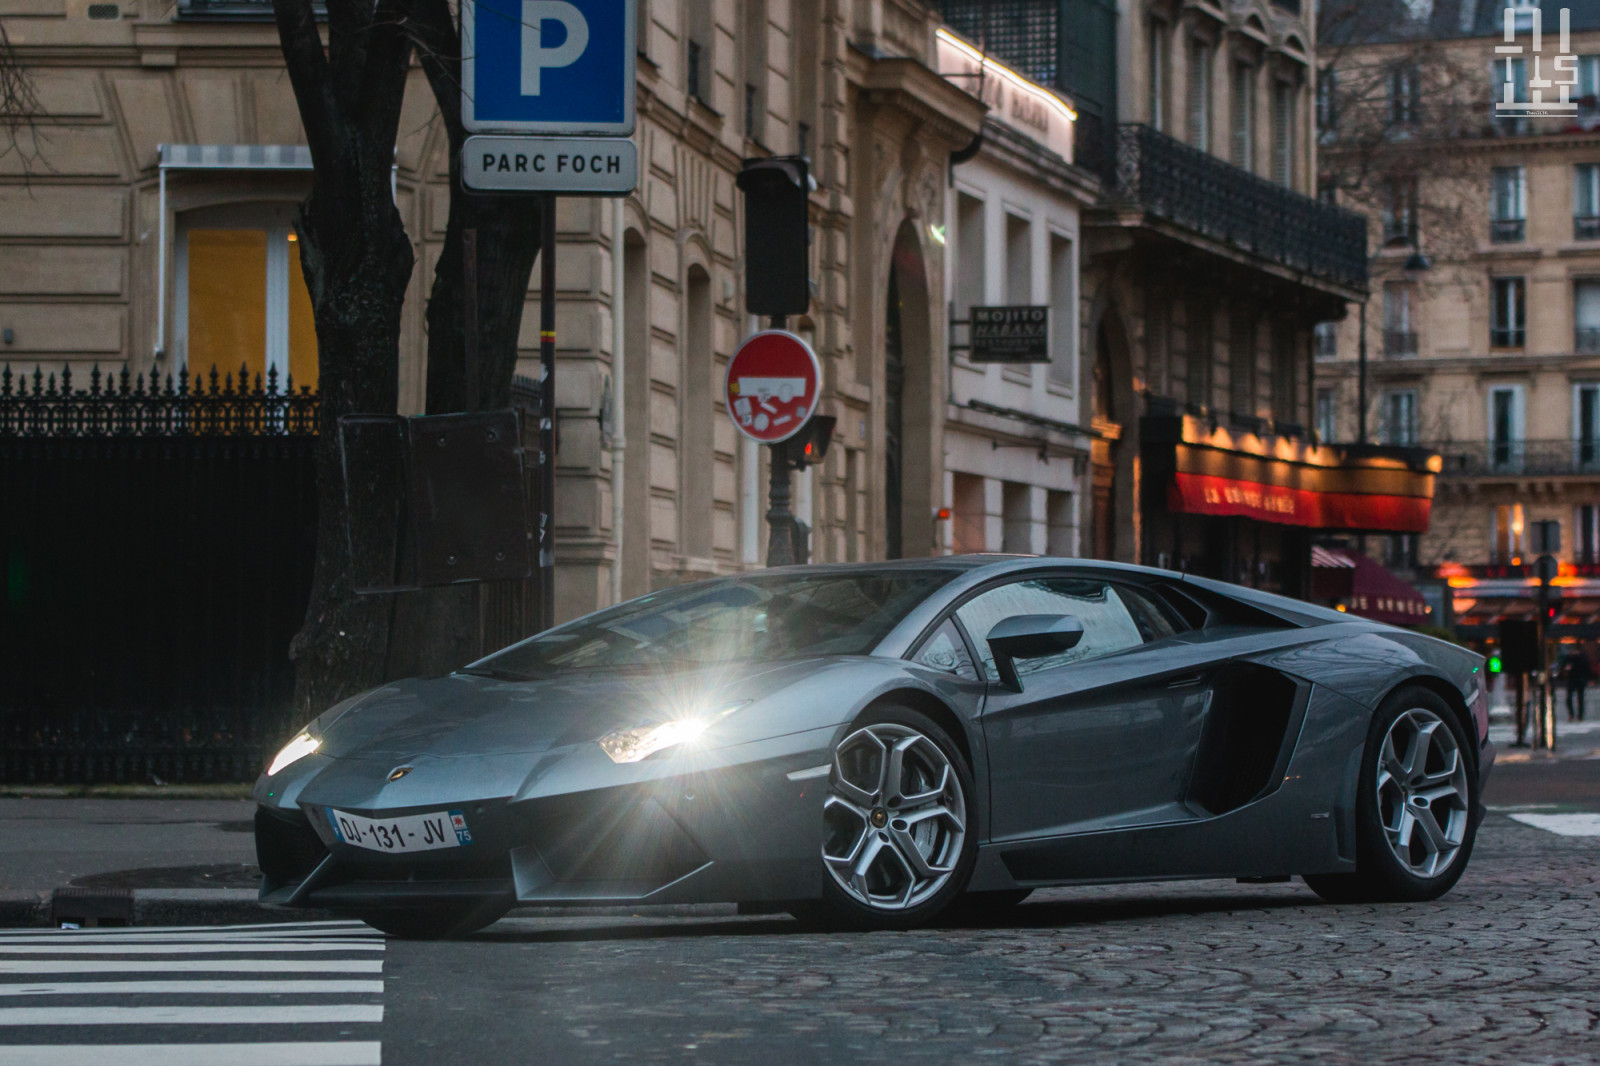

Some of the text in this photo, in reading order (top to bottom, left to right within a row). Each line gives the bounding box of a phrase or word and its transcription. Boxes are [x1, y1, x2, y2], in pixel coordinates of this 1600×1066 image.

[520, 0, 589, 96] P
[482, 153, 621, 174] PARC FOCH
[976, 310, 1044, 323] MOJITO
[456, 830, 472, 842] 75
